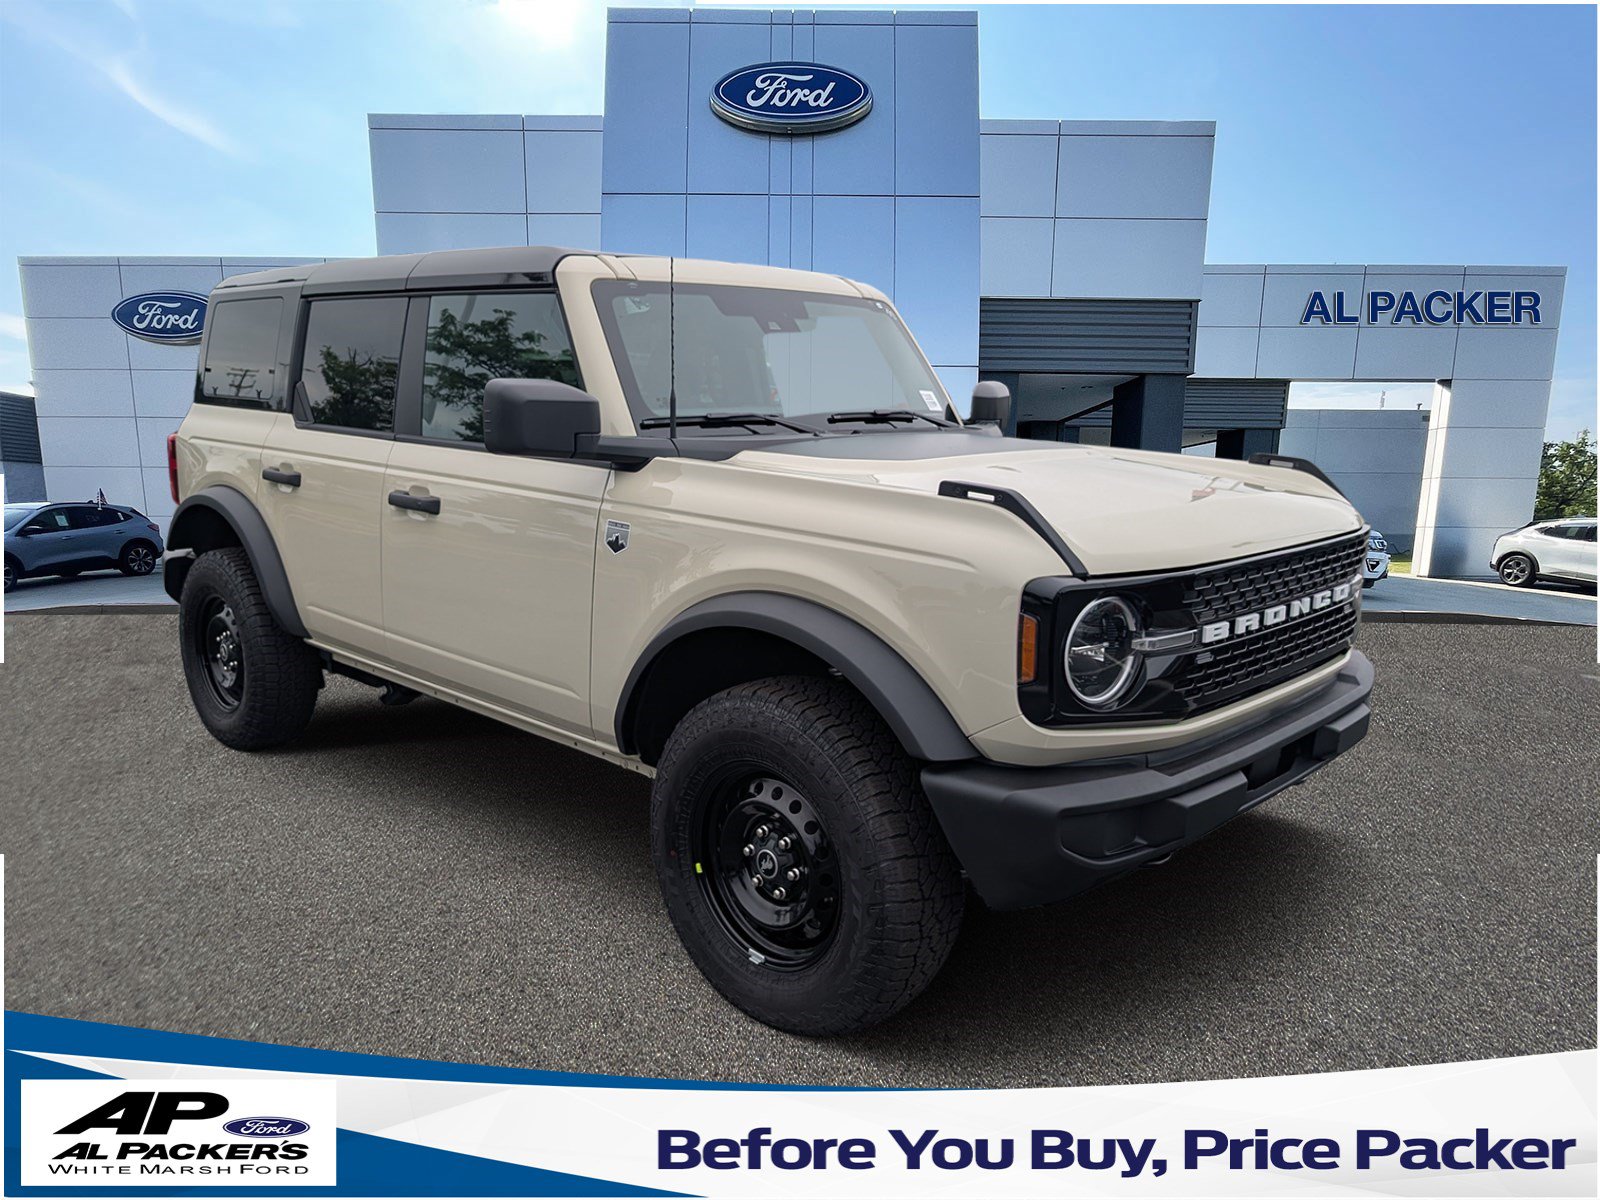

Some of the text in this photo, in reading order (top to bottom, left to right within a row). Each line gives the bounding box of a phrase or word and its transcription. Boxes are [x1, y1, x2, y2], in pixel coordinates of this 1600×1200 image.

[746, 73, 836, 108] Ford
[133, 300, 199, 330] Ford
[1302, 290, 1542, 324] AL PACKER
[1201, 583, 1350, 644] BRONCO
